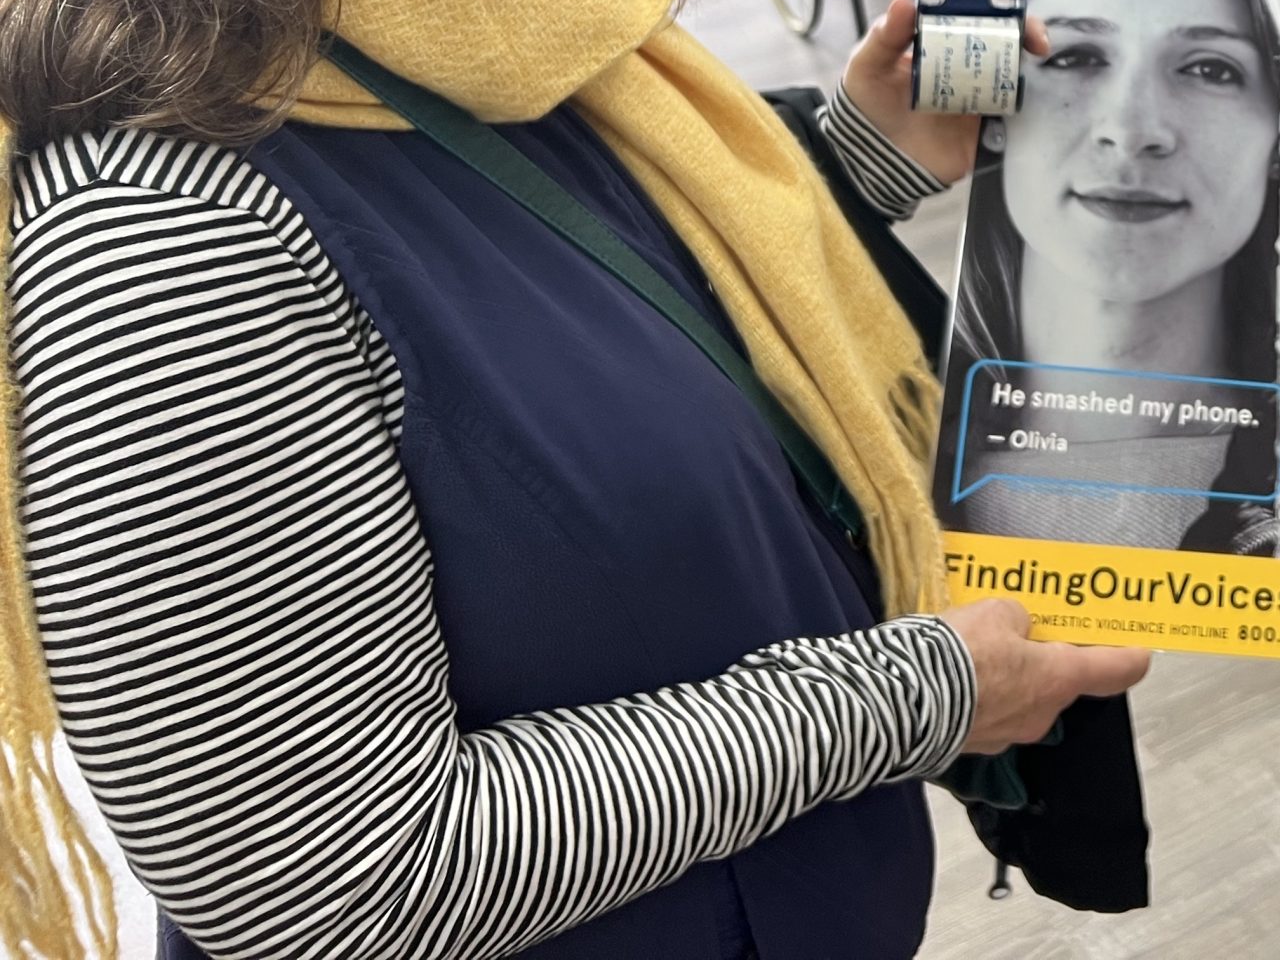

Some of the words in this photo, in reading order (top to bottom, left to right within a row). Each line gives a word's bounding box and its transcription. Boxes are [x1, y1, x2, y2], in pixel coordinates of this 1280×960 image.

[991, 383, 1026, 407] He
[1031, 390, 1134, 415] smashed
[1139, 400, 1175, 424] my
[1178, 400, 1261, 427] phone.
[1009, 429, 1069, 452] Olivia
[1030, 613, 1092, 629] OMESTIC
[1095, 618, 1165, 635] VIOLENCE
[1169, 622, 1230, 640] HOTLINE
